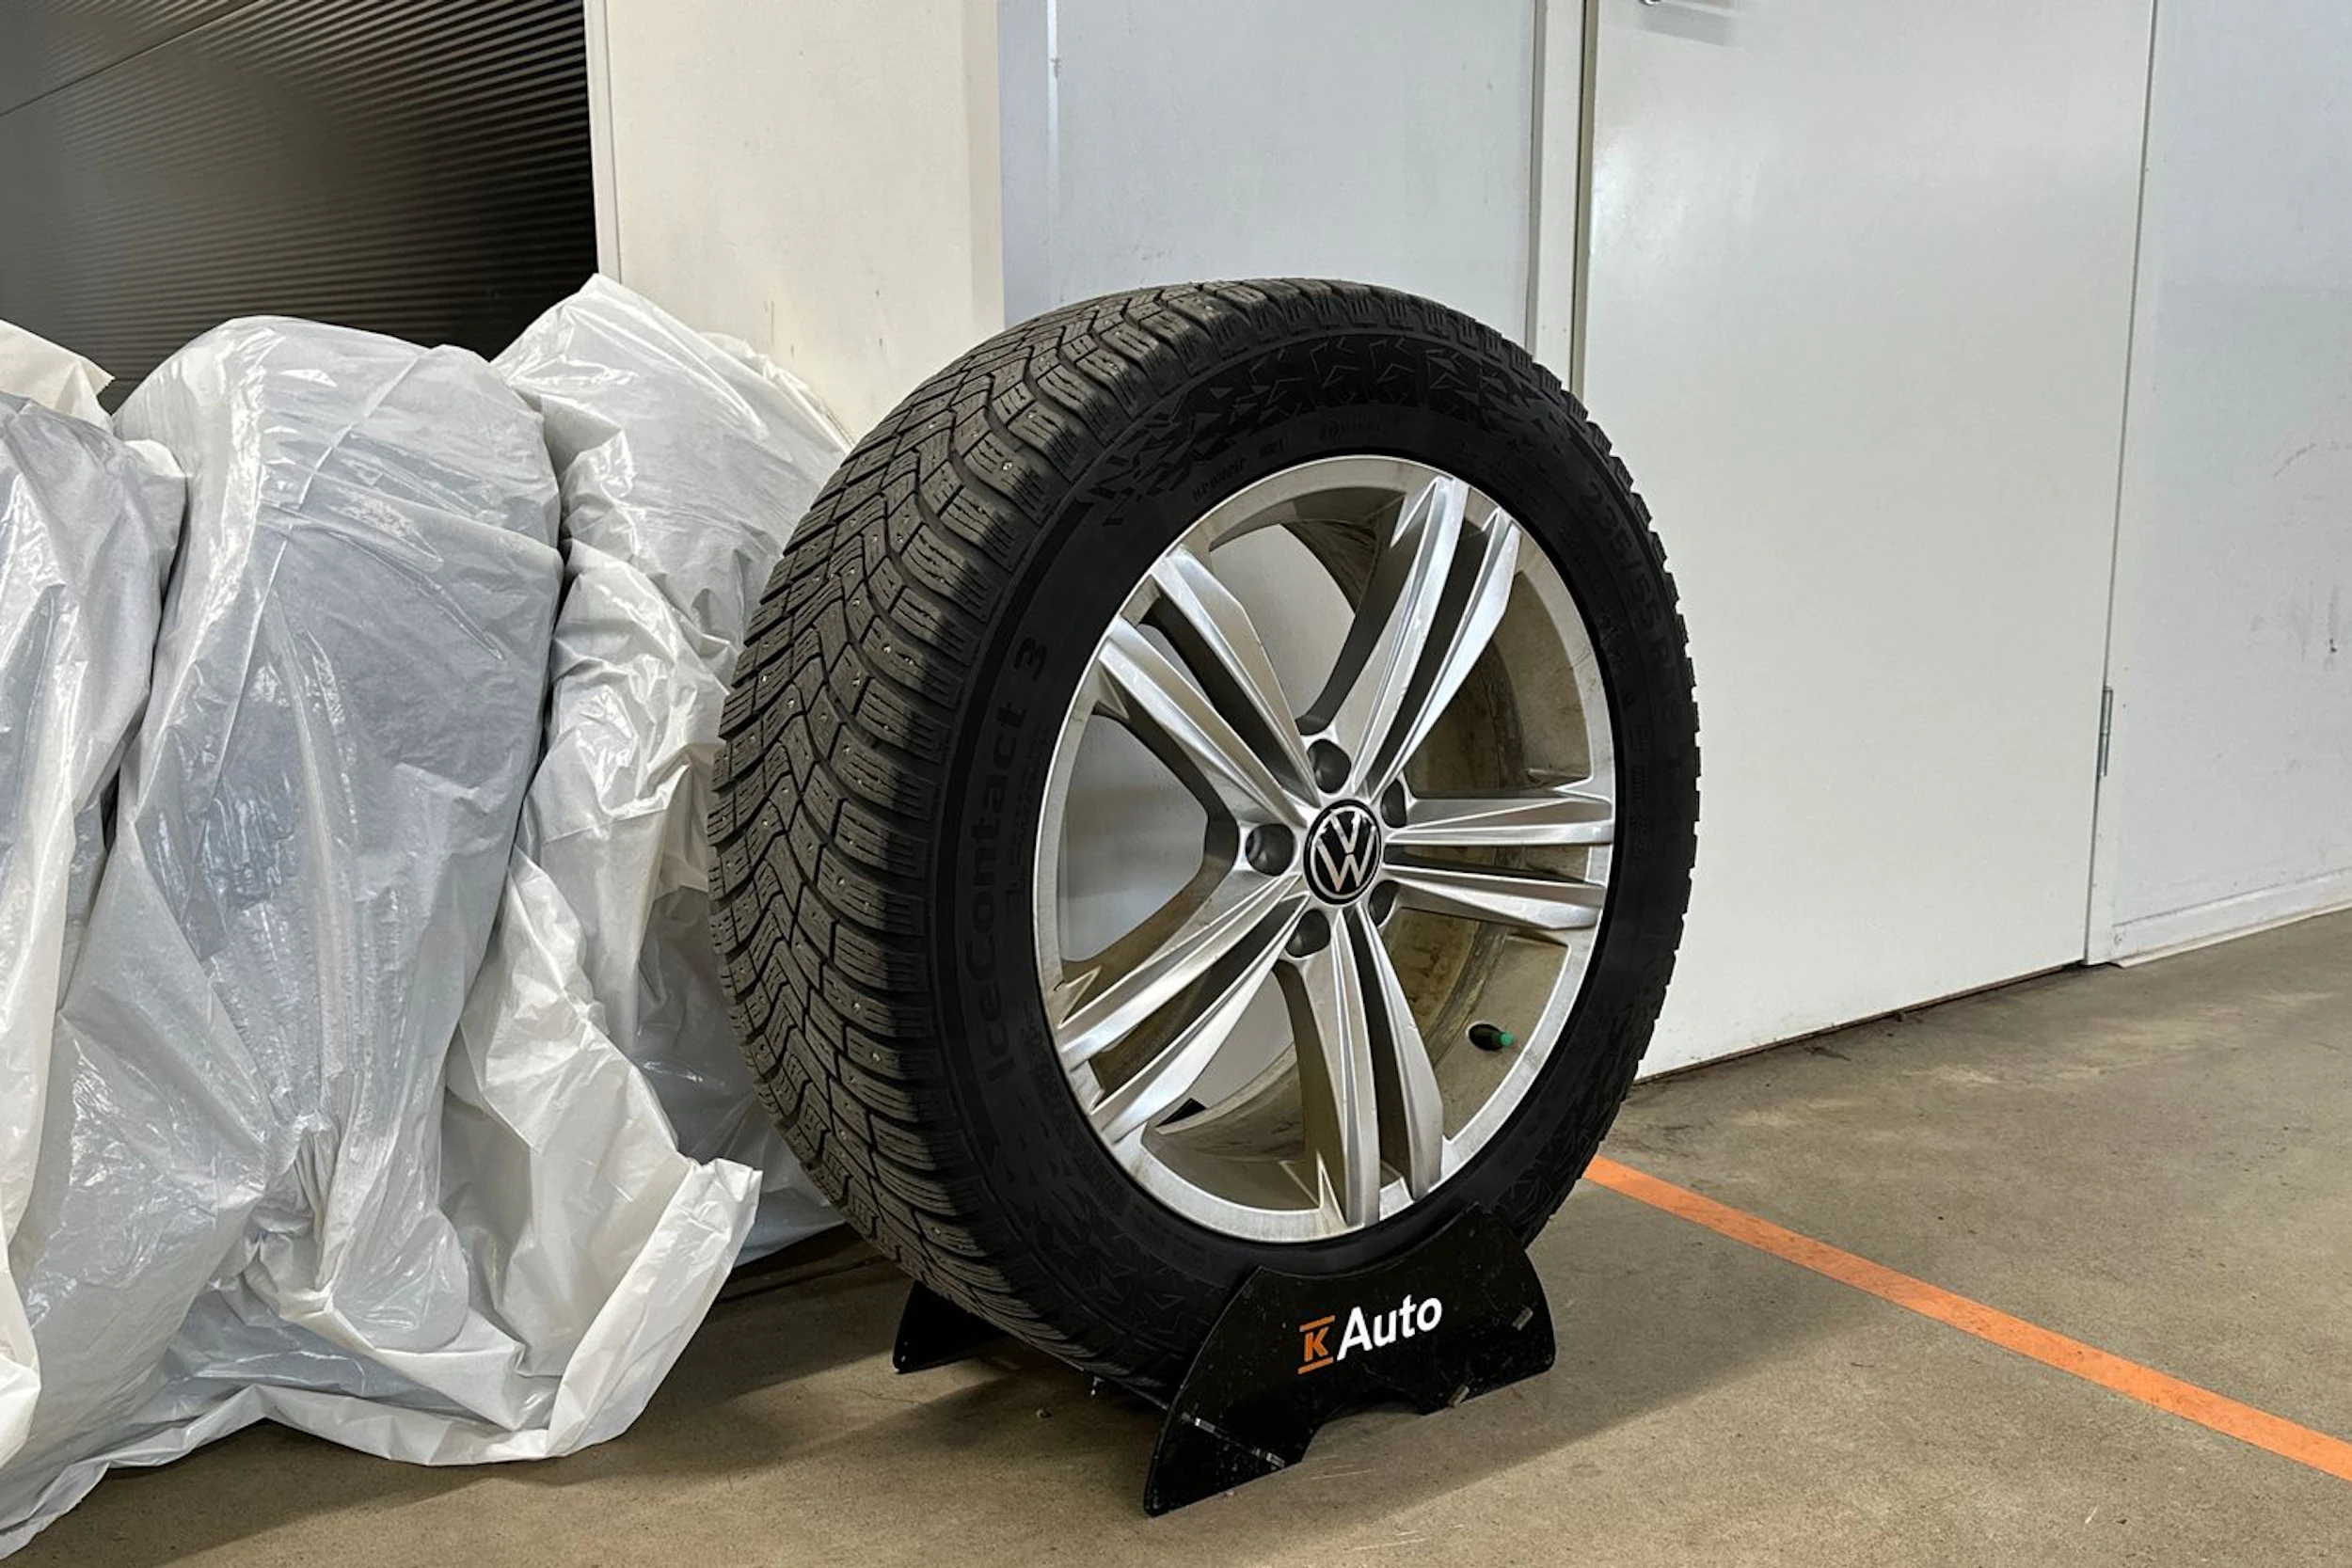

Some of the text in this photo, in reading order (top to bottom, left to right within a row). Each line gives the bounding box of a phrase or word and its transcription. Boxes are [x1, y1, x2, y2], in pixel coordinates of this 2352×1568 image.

[1580, 480, 1662, 632] 235/55
[965, 701, 1026, 1083] IceContact
[1013, 637, 1048, 683] 3
[1311, 805, 1380, 898] VW
[1336, 1293, 1443, 1362] Auto
